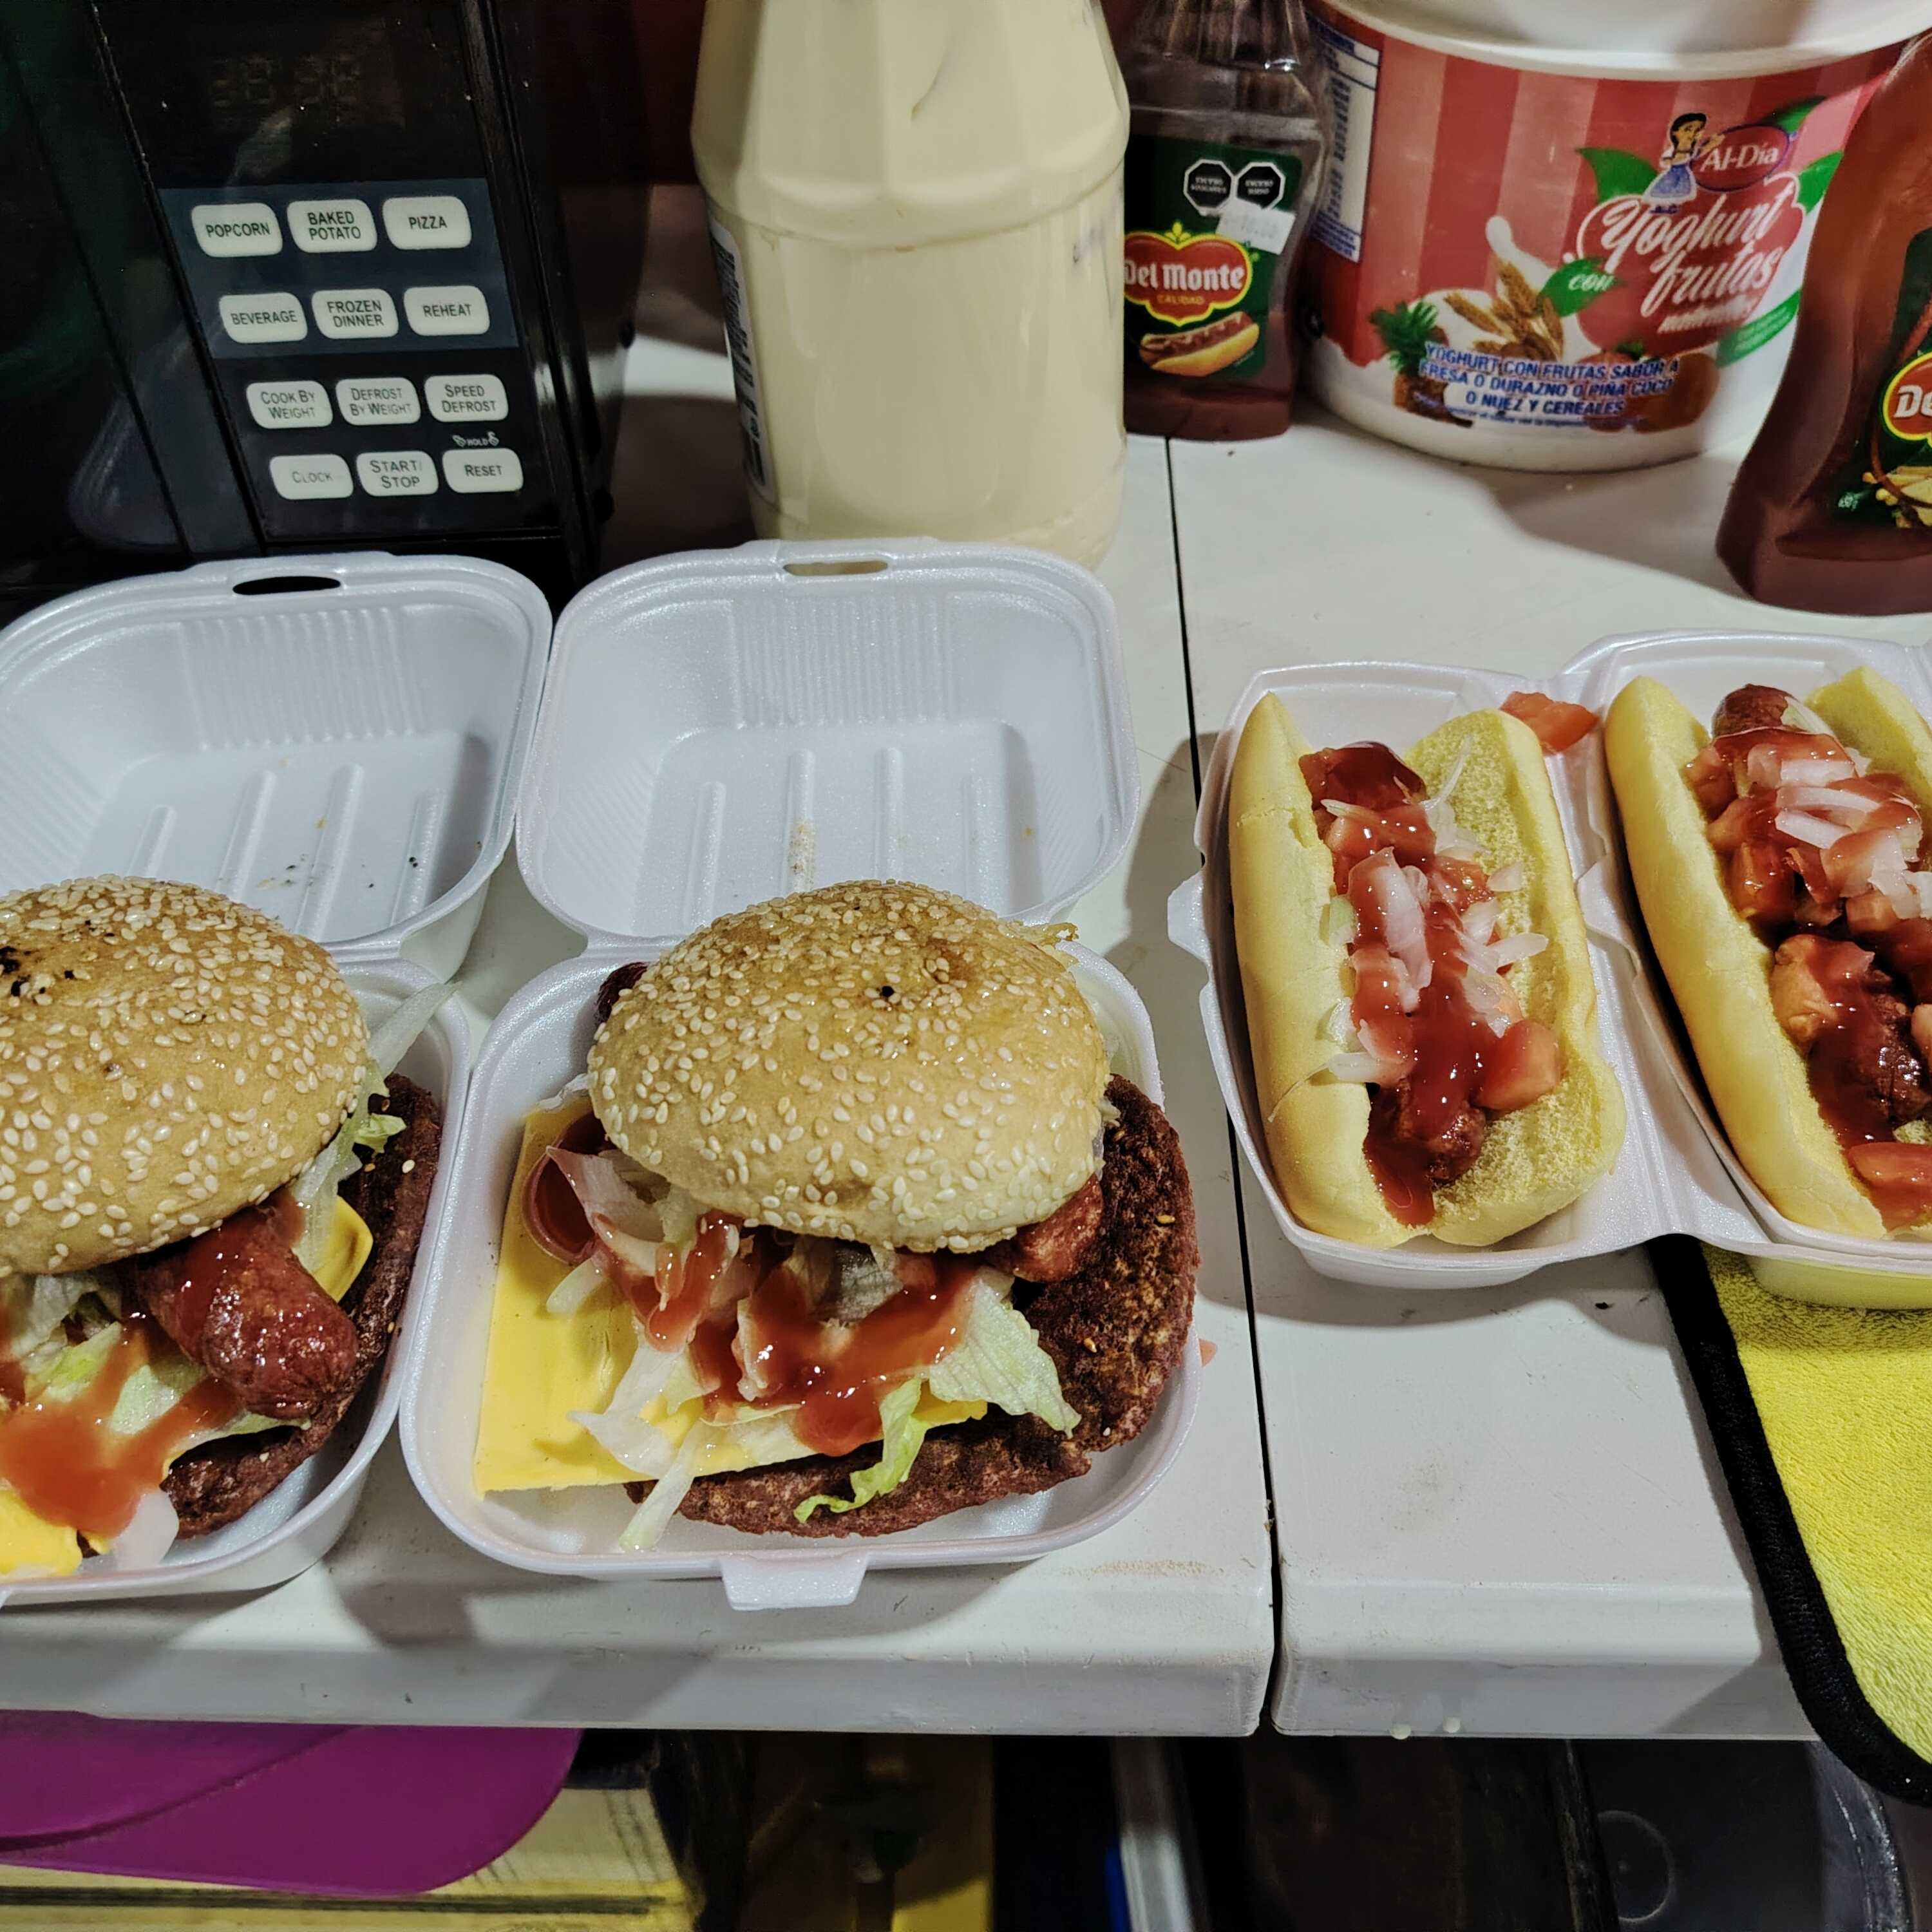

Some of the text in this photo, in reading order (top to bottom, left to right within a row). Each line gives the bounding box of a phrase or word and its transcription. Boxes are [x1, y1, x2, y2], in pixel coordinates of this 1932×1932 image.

[1700, 144, 1779, 172] Al-Día
[307, 211, 355, 225] BAKED
[409, 216, 448, 229] PIZZA
[206, 222, 270, 237] POPCORN
[309, 227, 361, 240] POTATO
[1601, 181, 1795, 273] Yoghurt
[1124, 260, 1244, 290] Del Monte
[1641, 240, 1785, 317] frutas
[1568, 274, 1614, 292] con
[327, 300, 382, 313] FROZEN
[422, 304, 471, 317] REHEAT
[231, 310, 298, 325] BEVERAGE
[334, 314, 384, 327] DINNER
[1425, 343, 1499, 372] YOGHURT
[1501, 360, 1542, 377] CON
[1544, 363, 1607, 379] FRUTAS
[1611, 361, 1665, 379] SABOR
[1421, 361, 1673, 398] FRESA O DURAZNO O PIÑA COCO
[260, 389, 315, 404] COOK BY
[351, 387, 402, 401] DEFROST
[444, 384, 485, 397] SPEED
[350, 402, 412, 416] BY WEIGHT
[442, 400, 496, 413] DEFROST
[1466, 393, 1477, 405] O
[1481, 395, 1522, 412] NUEZ
[1528, 400, 1540, 413] Y
[1544, 400, 1625, 416] CEREALES
[268, 406, 316, 419] WEIGHT
[466, 438, 489, 446] HOLD
[292, 470, 333, 483] CLOCK
[464, 464, 502, 477] RESET
[381, 475, 421, 489] STOP
